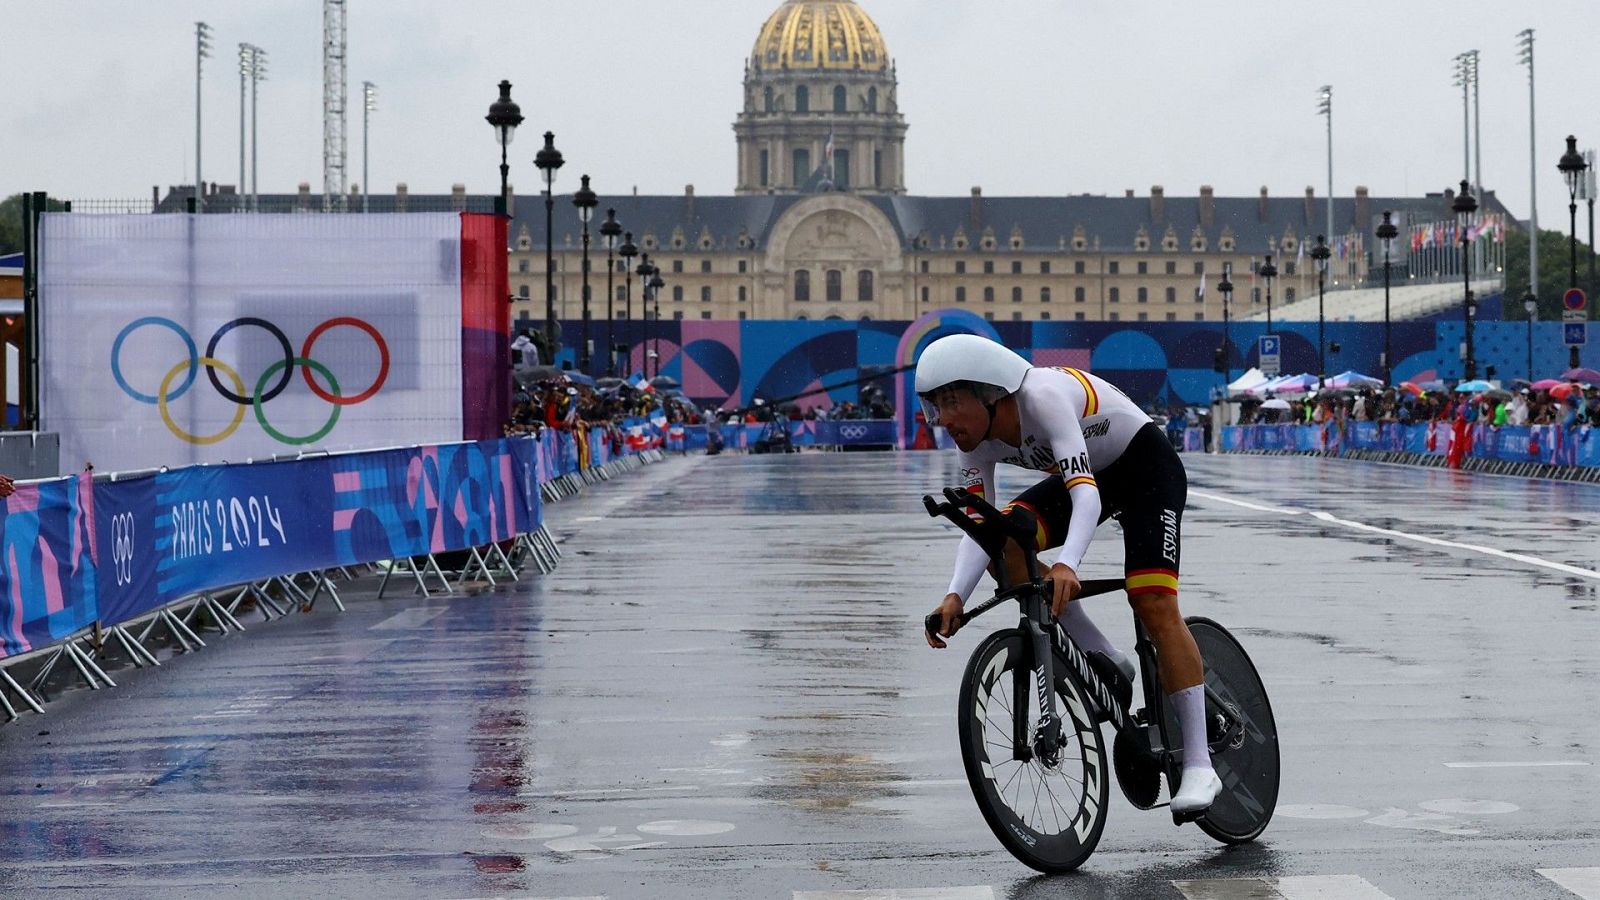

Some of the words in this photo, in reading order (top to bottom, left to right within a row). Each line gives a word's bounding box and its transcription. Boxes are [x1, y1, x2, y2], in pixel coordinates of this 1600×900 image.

[1264, 340, 1274, 353] P
[1059, 451, 1092, 479] PAÑ
[216, 495, 287, 552] 2024
[1161, 509, 1178, 564] ESPAÑA
[1036, 664, 1051, 727] CANYON
[1056, 622, 1124, 729] CANYON
